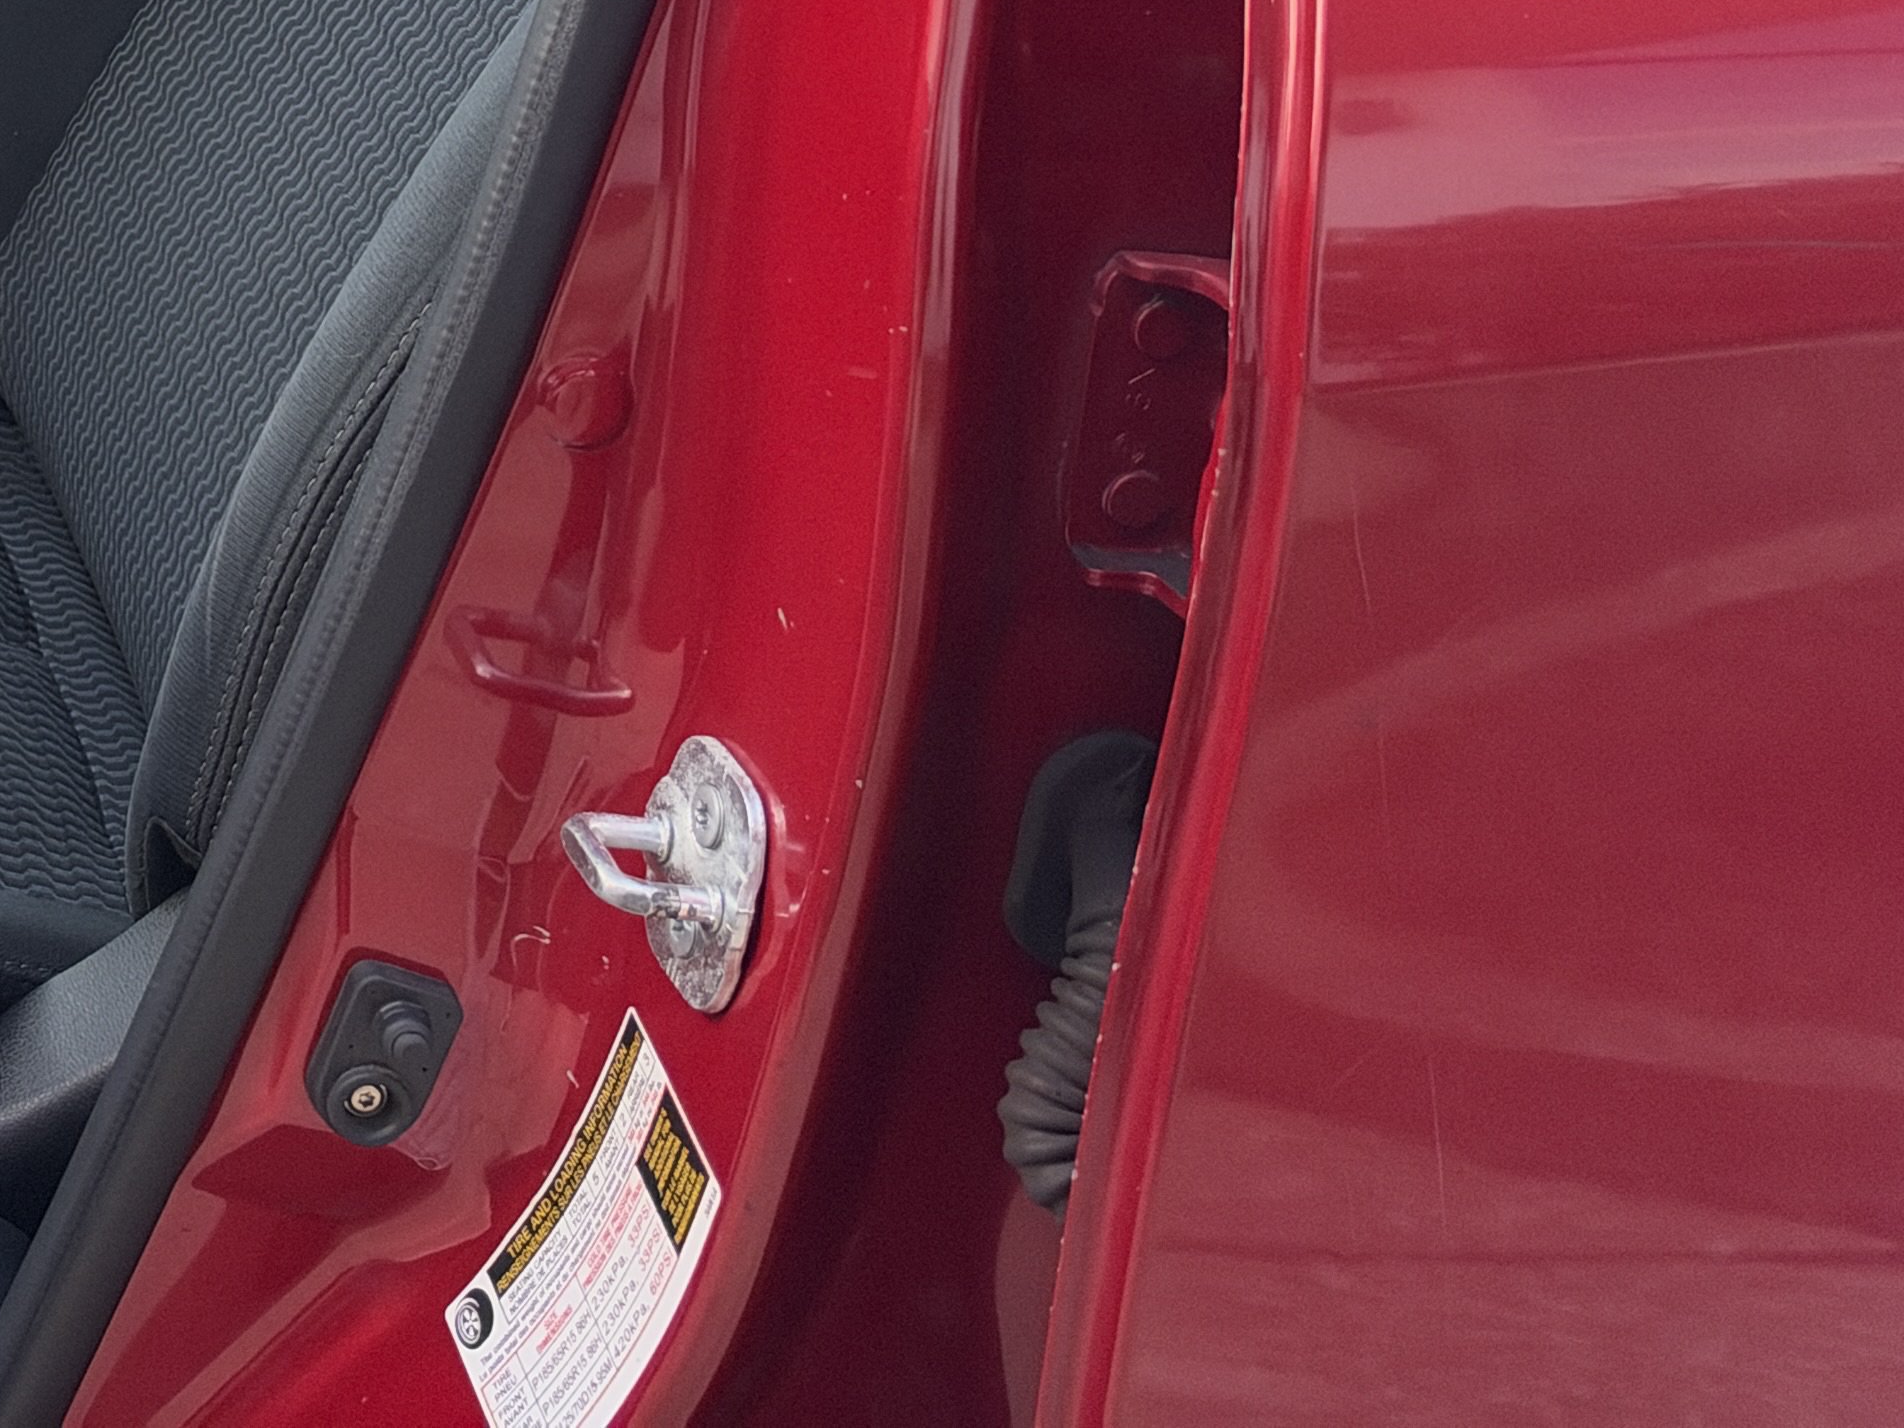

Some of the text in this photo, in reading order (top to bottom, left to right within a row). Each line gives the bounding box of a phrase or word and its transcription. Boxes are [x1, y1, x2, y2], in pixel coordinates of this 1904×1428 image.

[507, 1044, 625, 1261] TIRE AND LOADING INFORMATION
[591, 1171, 599, 1184] 5
[498, 1205, 559, 1293] RENSEIGNEMENTS
[557, 1183, 572, 1211] SUR
[570, 1164, 584, 1188] LES
[598, 1115, 608, 1135] ET
[604, 1102, 614, 1120] LE
[569, 1189, 586, 1219] TOTAL
[573, 1198, 590, 1227] TOTAL
[628, 1200, 651, 1246] 33PSI
[639, 1224, 661, 1270] 33PSI
[650, 1247, 673, 1294] 60PSI
[493, 1366, 510, 1391] TIRE
[533, 1332, 575, 1388] P185/65R15
[495, 1374, 516, 1402] PNEU
[498, 1386, 523, 1419] FRONT
[544, 1357, 585, 1413] P185/65R15
[504, 1395, 527, 1427] AVANT
